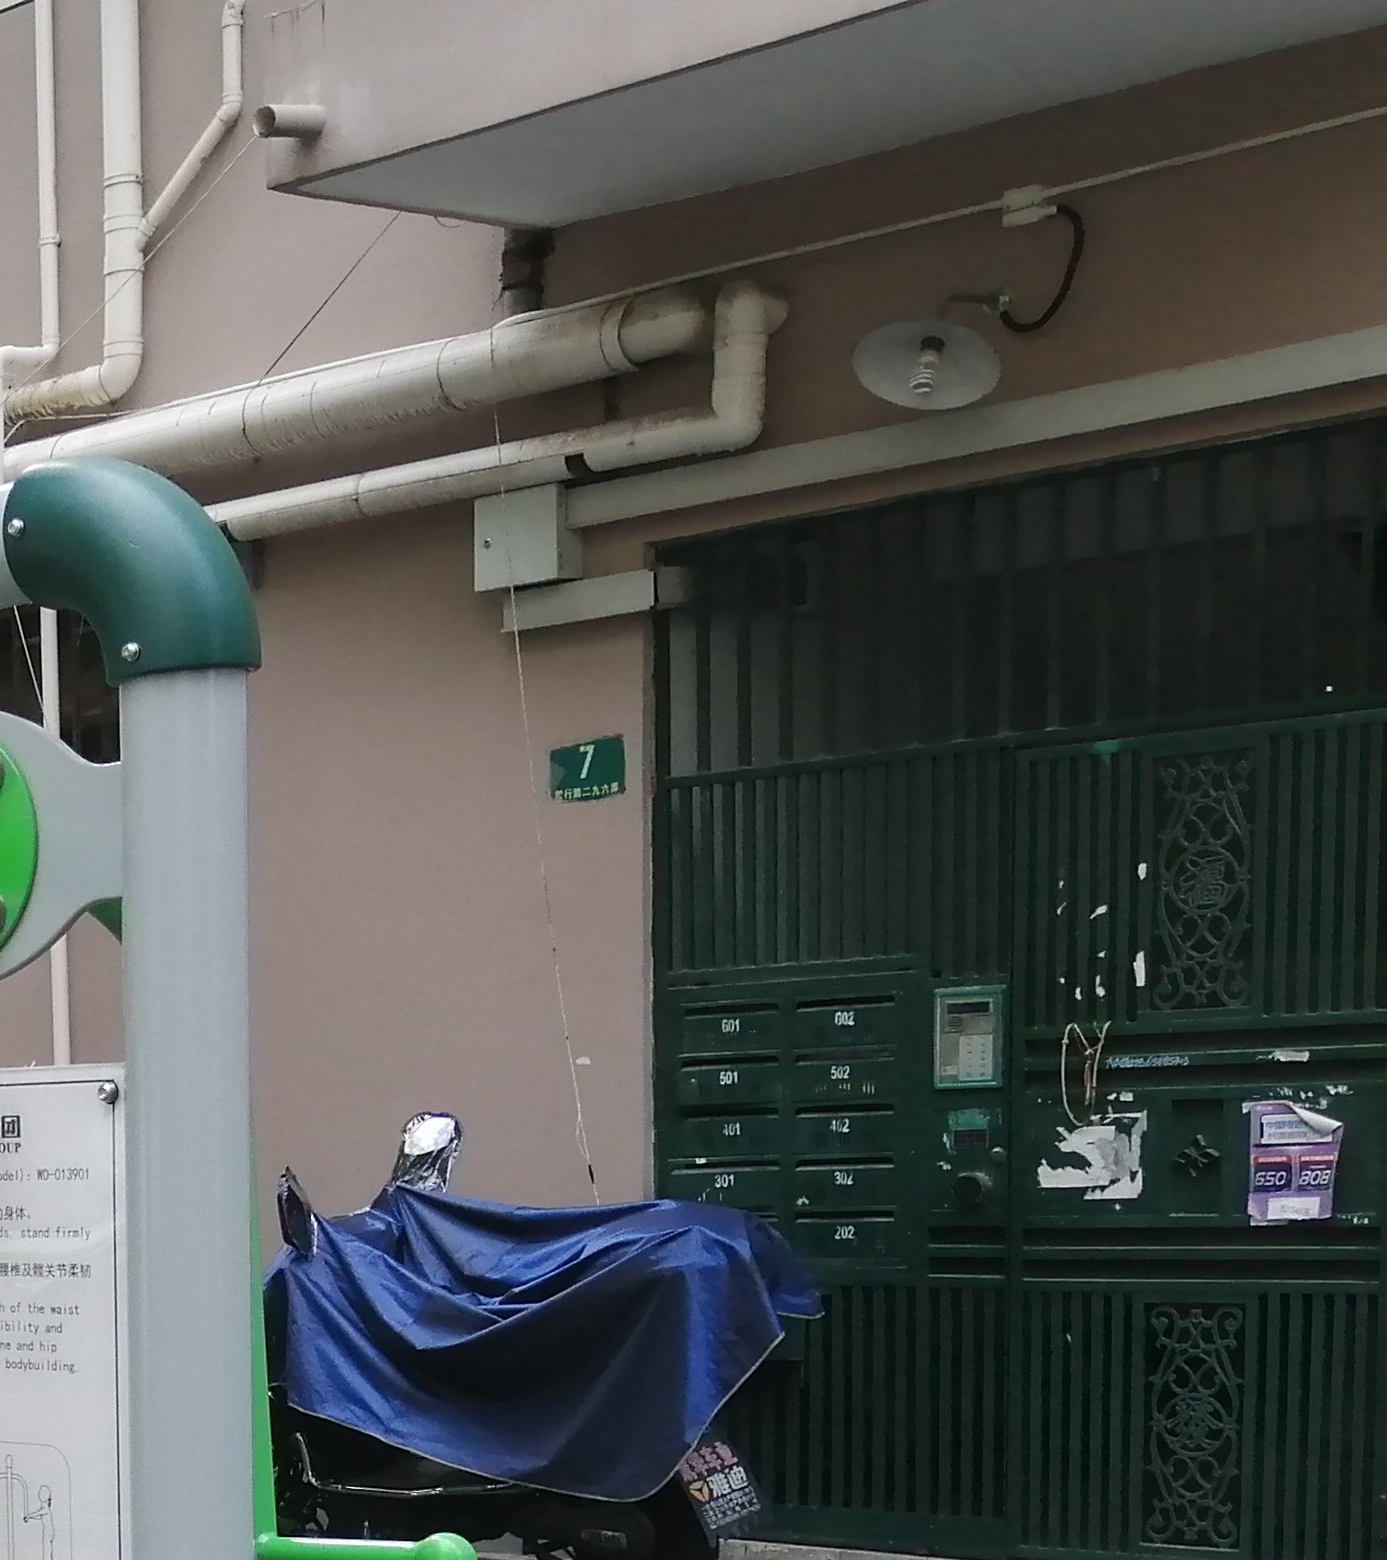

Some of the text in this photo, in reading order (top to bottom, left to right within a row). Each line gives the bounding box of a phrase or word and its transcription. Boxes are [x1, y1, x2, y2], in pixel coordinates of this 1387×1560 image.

[579, 744, 595, 779] 7
[721, 1018, 740, 1033] 601
[834, 1011, 855, 1026] 602
[719, 1070, 739, 1085] 501
[830, 1065, 850, 1079] 502
[37, 1168, 90, 1181] WD-013901
[715, 1173, 735, 1188] 301
[834, 1171, 854, 1186] 302
[1255, 1170, 1331, 1186] 650 808
[21, 1227, 50, 1238] stand
[55, 1227, 91, 1240] firmly
[834, 1226, 855, 1240] 202
[10, 1302, 21, 1313] of
[28, 1303, 45, 1314] the
[50, 1304, 80, 1315] waist
[45, 1323, 63, 1333] and
[16, 1341, 34, 1351] and
[39, 1341, 57, 1353] hip
[706, 1465, 750, 1498] 雅迪
